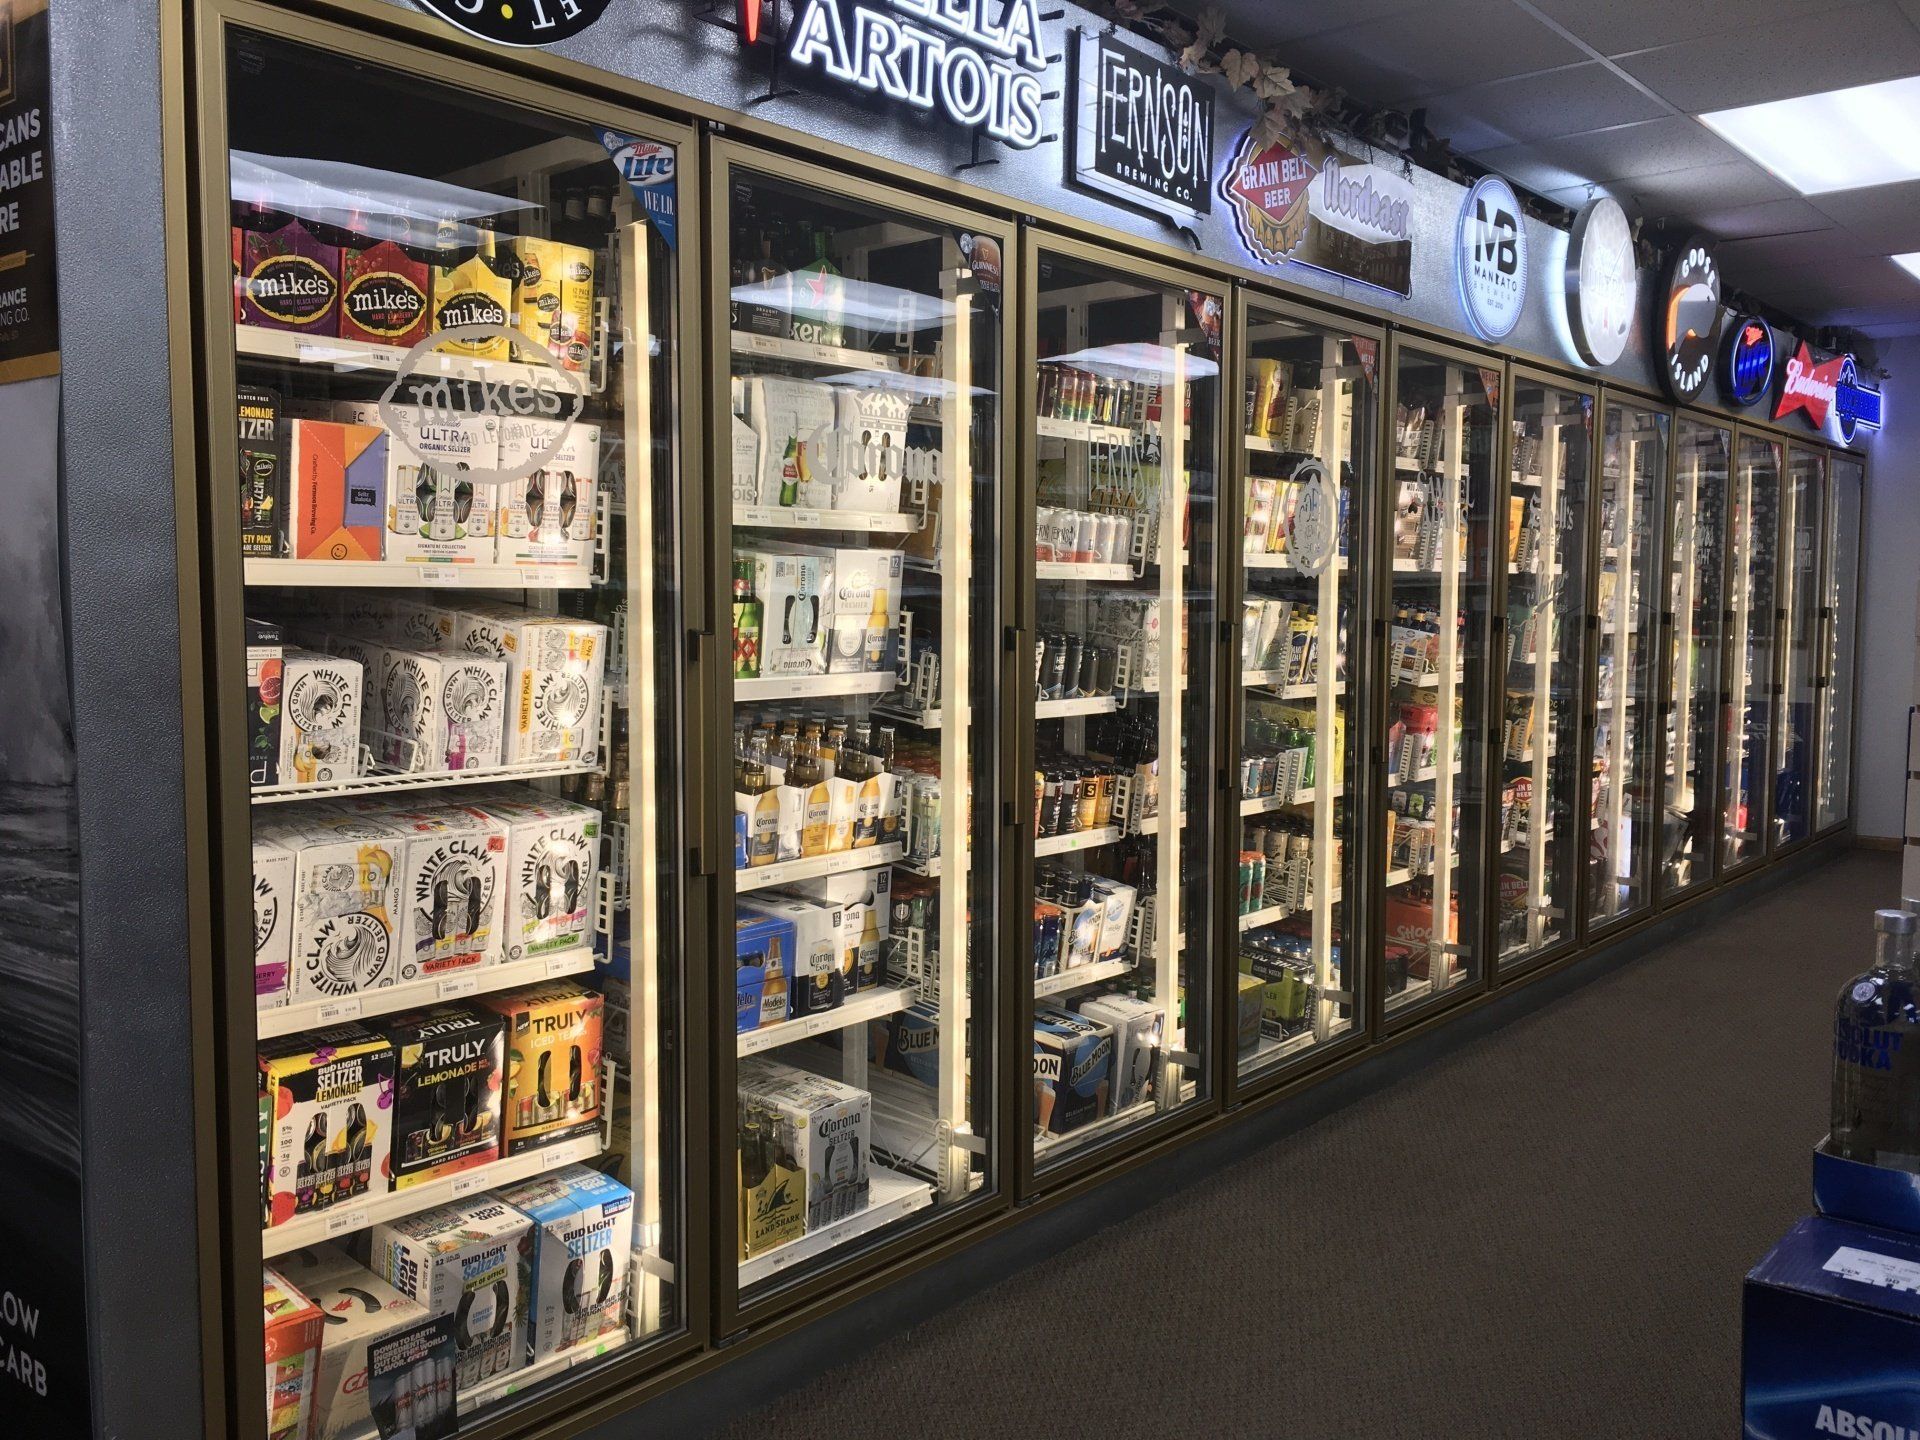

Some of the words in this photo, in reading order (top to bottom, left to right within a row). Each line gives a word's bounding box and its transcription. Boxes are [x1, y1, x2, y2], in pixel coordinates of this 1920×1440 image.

[790, 0, 1043, 148] ARTOIS
[1101, 48, 1210, 188] FERNSON
[631, 142, 663, 157] Miller
[622, 154, 673, 182] Lite
[1242, 162, 1279, 190] GRAIN
[1282, 154, 1307, 183] BELT
[1116, 162, 1169, 192] BREWING
[1176, 187, 1193, 202] CO.
[644, 190, 658, 212] WE
[1264, 188, 1292, 209] BEER
[1323, 156, 1409, 240] Nordeast
[1475, 198, 1518, 275] MB
[569, 266, 591, 277] mike's
[1474, 264, 1518, 293] MANKATO
[1681, 247, 1716, 289] GOOSE
[258, 272, 330, 298] mike's
[353, 287, 420, 312] mike's
[538, 297, 560, 307] mike's
[371, 312, 384, 321] HARD
[444, 303, 504, 327] mike's
[1671, 353, 1709, 392] ISLAND
[409, 366, 562, 428] mike's
[420, 426, 470, 443] ULTRA
[419, 442, 447, 452] ORGANIC
[447, 445, 471, 454] SELTZER
[257, 535, 272, 544] PACK
[892, 557, 900, 568] 12
[798, 564, 807, 601] Corona
[839, 586, 871, 601] Corona
[480, 627, 506, 659] CLAW
[867, 634, 888, 644] Corona
[403, 658, 430, 693] WHITE
[783, 658, 813, 669] Corona
[446, 676, 459, 699] HARD
[463, 666, 495, 689] WHITE
[524, 673, 532, 694] PACK
[293, 680, 307, 705] HARD
[313, 668, 349, 693] WHITE
[331, 693, 352, 729] CLAW
[534, 673, 554, 710] CLAW
[414, 695, 432, 737] CLAW
[445, 702, 472, 723] SELTZER
[478, 689, 498, 722] CLAW
[521, 694, 532, 731] VARIETY
[292, 708, 323, 732] SELTZER
[1087, 784, 1095, 797] S
[756, 816, 778, 827] Corona
[808, 808, 829, 819] Corona
[521, 835, 547, 888] WHITE
[549, 828, 589, 851] CLAW
[416, 846, 448, 903] WHITE
[449, 839, 493, 867] CLAW
[879, 873, 887, 882] 12
[834, 912, 841, 921] 12
[347, 915, 386, 945] SELTZER
[306, 919, 337, 971] CLAW
[531, 940, 557, 953] VARIETY
[558, 934, 578, 947] PACK
[860, 949, 878, 960] Corona
[366, 946, 386, 978] HARD
[425, 958, 457, 972] VARIETY
[458, 954, 478, 967] PACK
[810, 952, 835, 967] Corona
[815, 962, 830, 971] Extra
[863, 956, 875, 964] Extra
[309, 971, 358, 997] WHITE
[276, 1000, 283, 1008] 12
[762, 997, 786, 1010] Modelo
[532, 1009, 588, 1035] TRULY
[530, 1036, 555, 1049] ICED
[898, 1026, 931, 1050] BLUE
[371, 1053, 380, 1061] 12
[425, 1038, 486, 1069] TRULY
[1070, 1055, 1093, 1085] BLUE
[1092, 1036, 1111, 1064] MOON
[318, 1062, 336, 1076] BUD
[337, 1057, 363, 1071] LIGHT
[418, 1062, 477, 1088] LEMONADE
[317, 1067, 363, 1091] SELTZER
[316, 1082, 364, 1103] LEMONADE
[342, 1096, 357, 1104] PACK
[818, 1112, 861, 1139] Corona
[281, 1138, 293, 1146] 100
[828, 1130, 856, 1146] SELTZER
[431, 1157, 447, 1166] HARD
[447, 1149, 470, 1160] SELTZER
[544, 1224, 554, 1234] 12
[563, 1228, 585, 1243] BUD
[586, 1217, 617, 1235] LIGHT
[461, 1255, 481, 1268] BUD
[481, 1244, 508, 1261] LIGHT
[567, 1228, 613, 1260] SELTZER
[435, 1258, 444, 1266] 12
[462, 1252, 507, 1282] Seltzer
[407, 1259, 418, 1301] BUD
[465, 1280, 478, 1290] OUT
[478, 1277, 486, 1286] OF
[487, 1269, 506, 1282] OFFICE
[0, 1290, 39, 1340] OW
[373, 1338, 427, 1364] INGREDIENTS.
[374, 1341, 398, 1356] DOWN
[399, 1337, 410, 1346] TO
[410, 1325, 436, 1342] EARTH
[374, 1357, 389, 1370] OUT
[419, 1335, 448, 1353] WORLD
[0, 1343, 47, 1397] ARB
[374, 1360, 407, 1377] FLAVOR.
